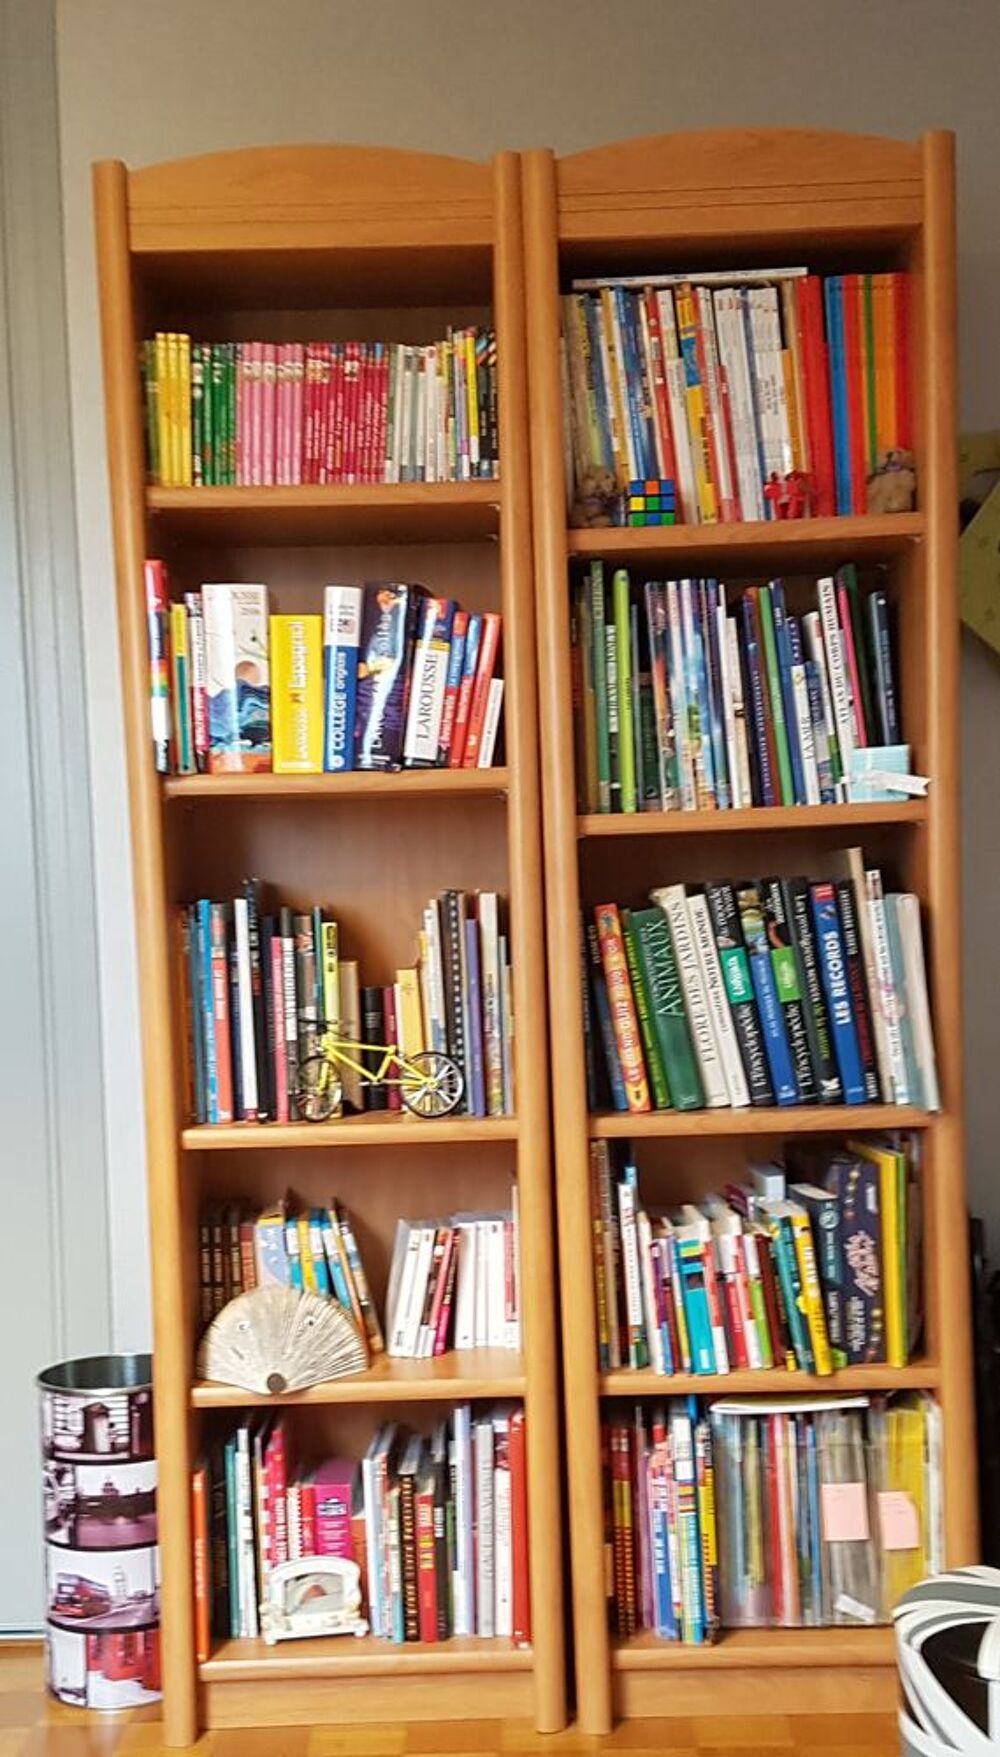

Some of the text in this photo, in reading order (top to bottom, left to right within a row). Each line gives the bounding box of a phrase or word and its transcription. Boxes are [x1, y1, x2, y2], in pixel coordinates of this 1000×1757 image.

[828, 632, 841, 671] CORPS
[416, 652, 437, 740] LAROUSSE
[836, 689, 850, 725] ATLAS
[694, 907, 711, 949] MONDE
[645, 918, 686, 1018] ANIMAUX
[669, 901, 717, 1063] FLORE DES JARDINS
[703, 950, 721, 989] NOTRE
[823, 930, 851, 1024] LES RECORDS
